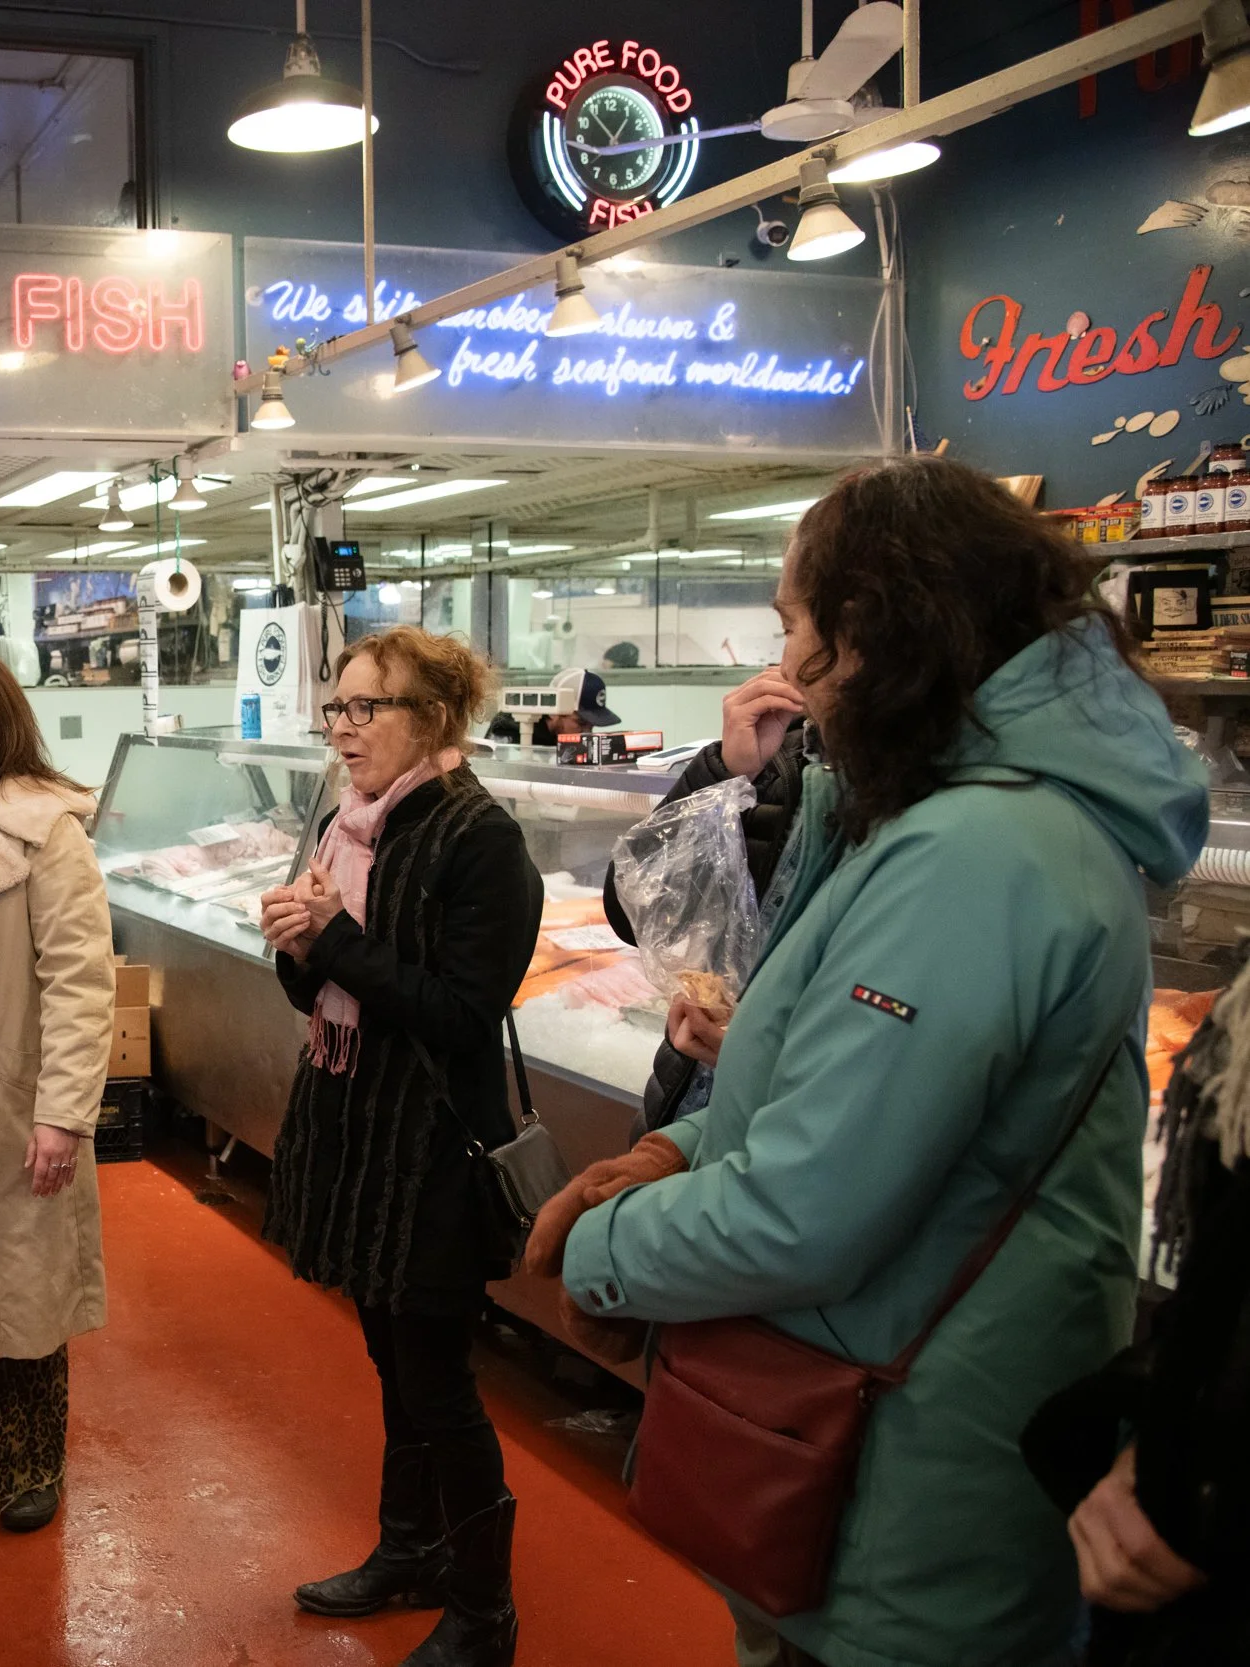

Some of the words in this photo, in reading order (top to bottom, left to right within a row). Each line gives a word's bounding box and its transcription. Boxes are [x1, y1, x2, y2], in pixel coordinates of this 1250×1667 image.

[546, 40, 614, 110] PURE
[622, 40, 692, 113] FOOD
[604, 99, 617, 111] 12
[624, 105, 630, 117] 1
[577, 117, 589, 129] 10
[635, 119, 643, 131] 2
[581, 152, 589, 164] 8
[636, 155, 644, 166] 4
[593, 167, 601, 179] 7
[609, 173, 617, 185] 6
[626, 168, 634, 180] 5
[12, 272, 206, 353] FISH
[265, 280, 332, 322] We
[435, 293, 557, 333] moke
[596, 302, 697, 340] almon
[708, 302, 736, 341] &
[959, 264, 1242, 401] Fresh
[448, 335, 539, 387] fresh
[552, 346, 677, 396] seafood
[685, 352, 864, 395] worldwide!
